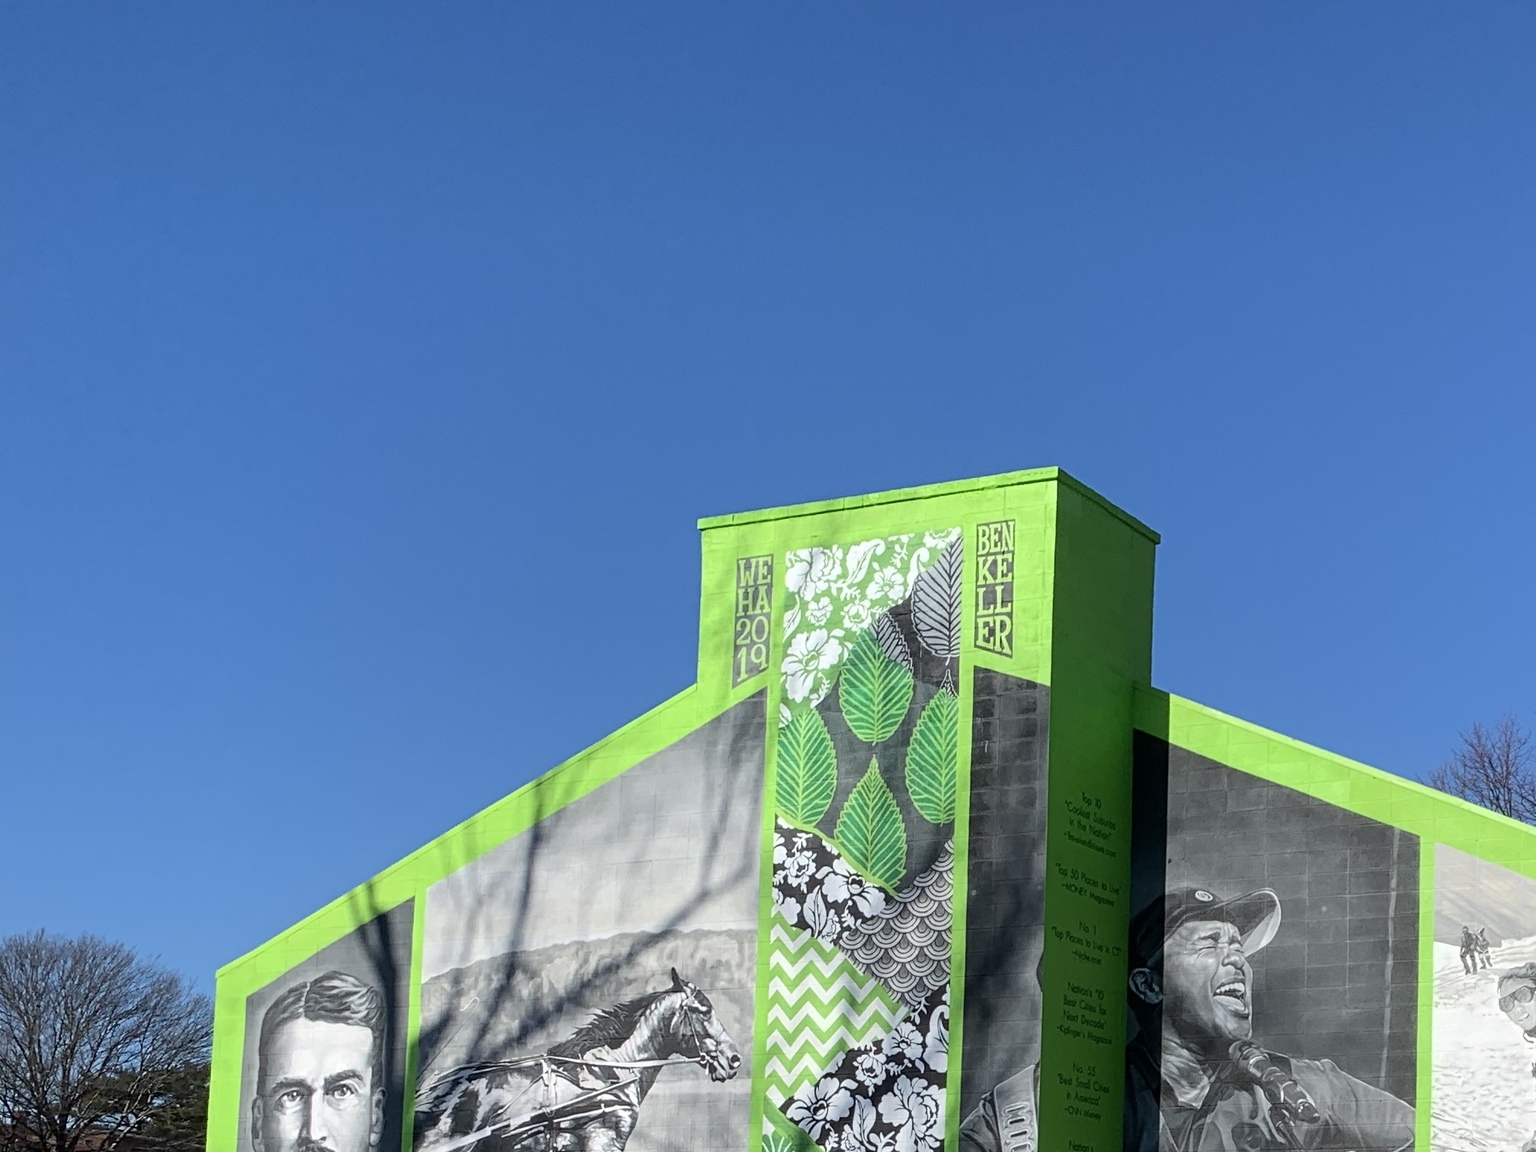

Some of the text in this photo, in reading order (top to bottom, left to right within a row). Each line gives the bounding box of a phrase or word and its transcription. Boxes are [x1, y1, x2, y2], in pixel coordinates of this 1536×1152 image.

[978, 521, 1015, 555] BEN
[739, 556, 771, 586] WE
[977, 553, 1013, 585] KE
[737, 586, 770, 616] HA
[977, 586, 1011, 616] LL
[736, 616, 769, 645] 20
[976, 615, 1012, 655] ER
[737, 644, 767, 682] 19
[1070, 868, 1079, 880] 50
[1081, 872, 1098, 887] Places
[1101, 882, 1107, 891] to
[1090, 891, 1114, 907] Magazine
[1066, 931, 1083, 945] Places
[1085, 939, 1091, 948] to
[1064, 994, 1107, 1015] Best Cities for
[1064, 1009, 1078, 1022] Next
[1087, 1031, 1112, 1045] Magazine
[1087, 1065, 1096, 1077] 55
[1076, 1077, 1090, 1090] Small
[1093, 1081, 1110, 1094] Cities
